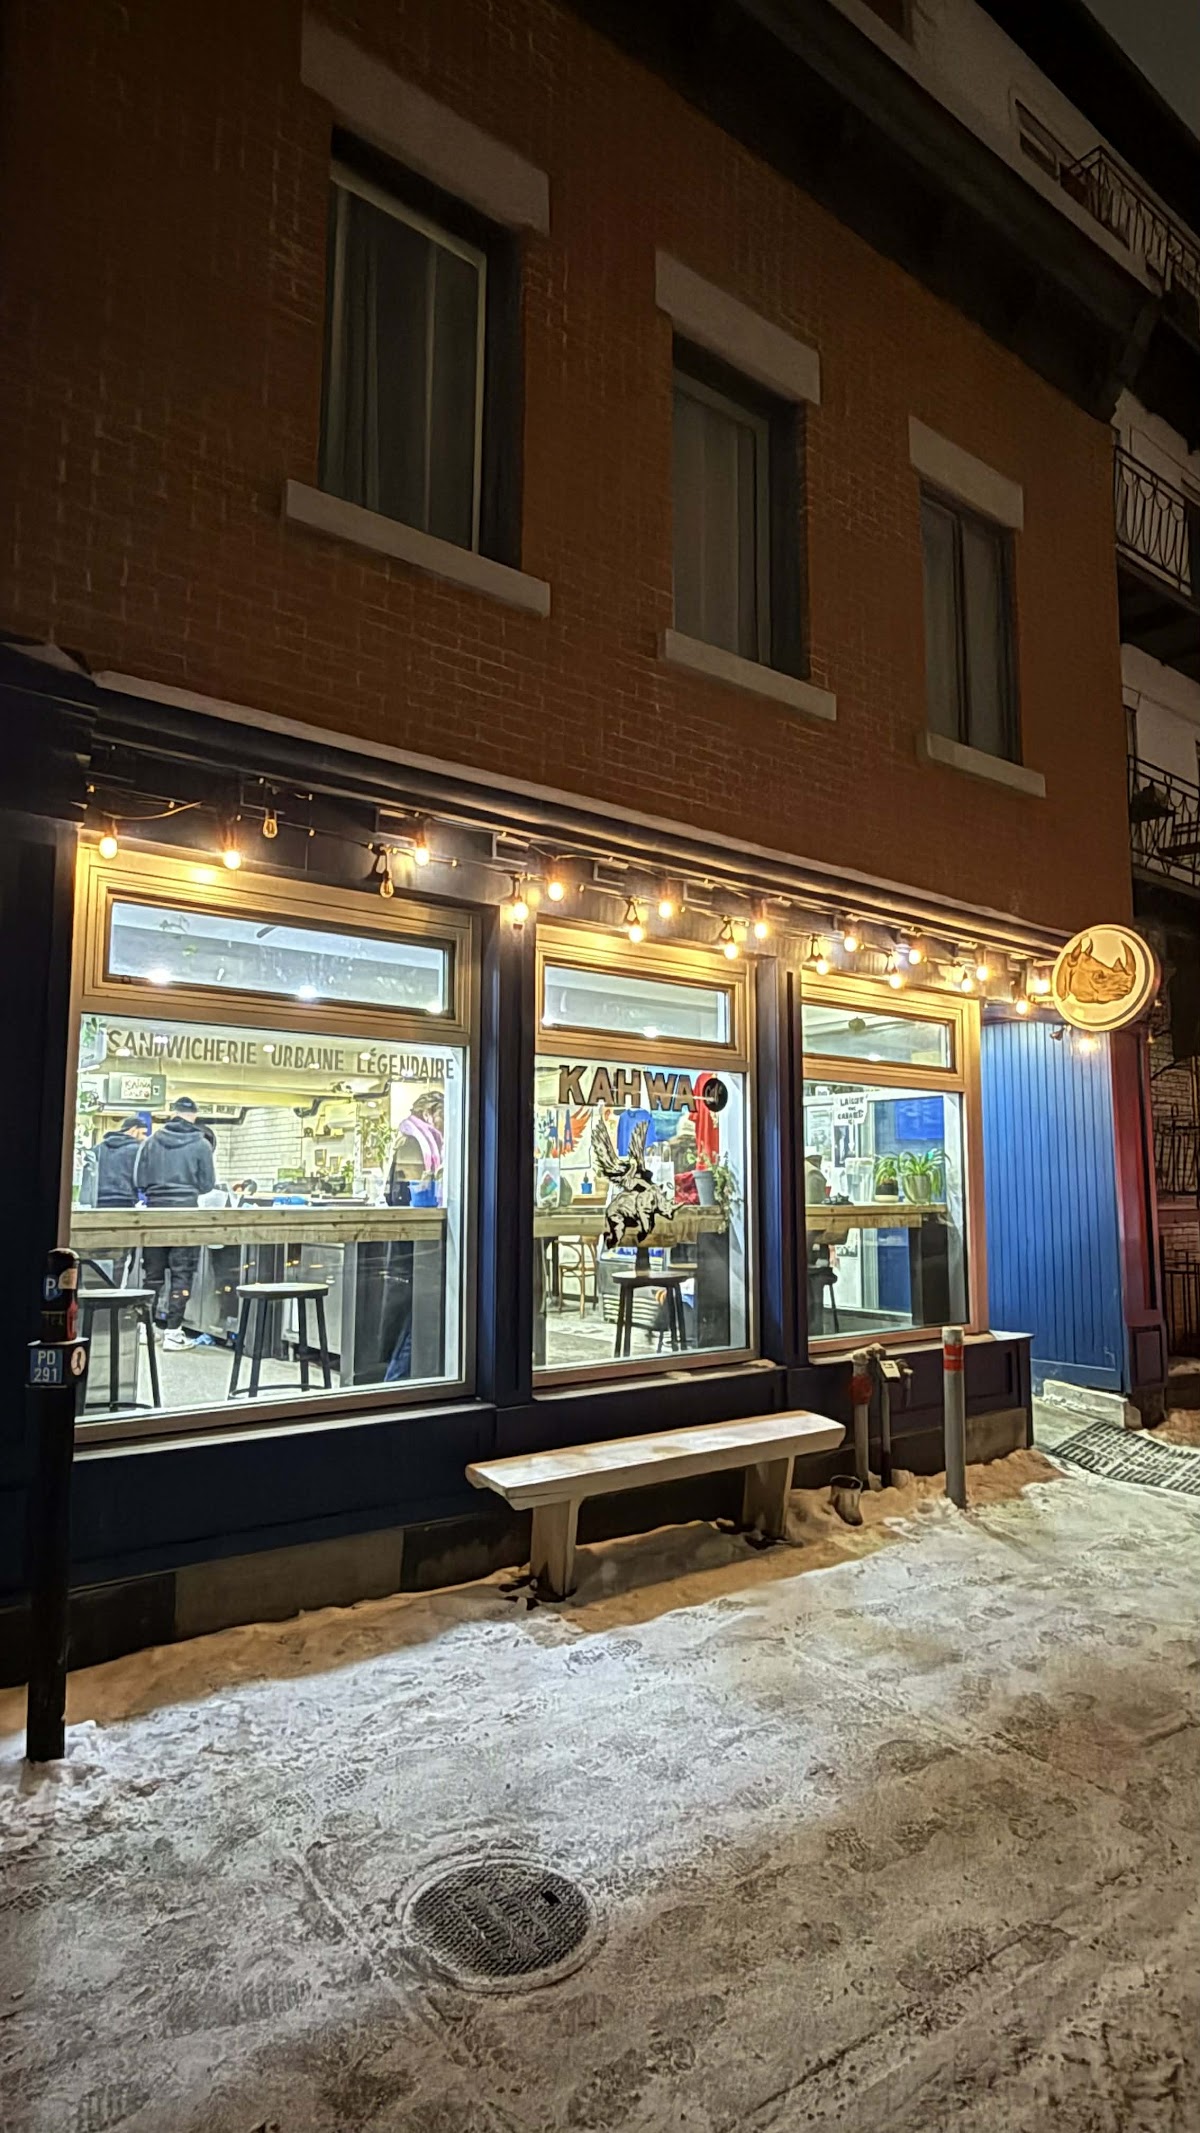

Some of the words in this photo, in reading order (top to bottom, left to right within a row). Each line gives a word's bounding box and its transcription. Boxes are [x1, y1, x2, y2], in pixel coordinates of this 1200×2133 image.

[107, 1030, 257, 1065] SANDWICHERIE
[271, 1044, 344, 1072] URBAINE
[356, 1048, 455, 1080] LÉGENDAIRE
[558, 1064, 698, 1113] KAHWA
[37, 1350, 57, 1366] PD
[33, 1367, 58, 1383] 291
